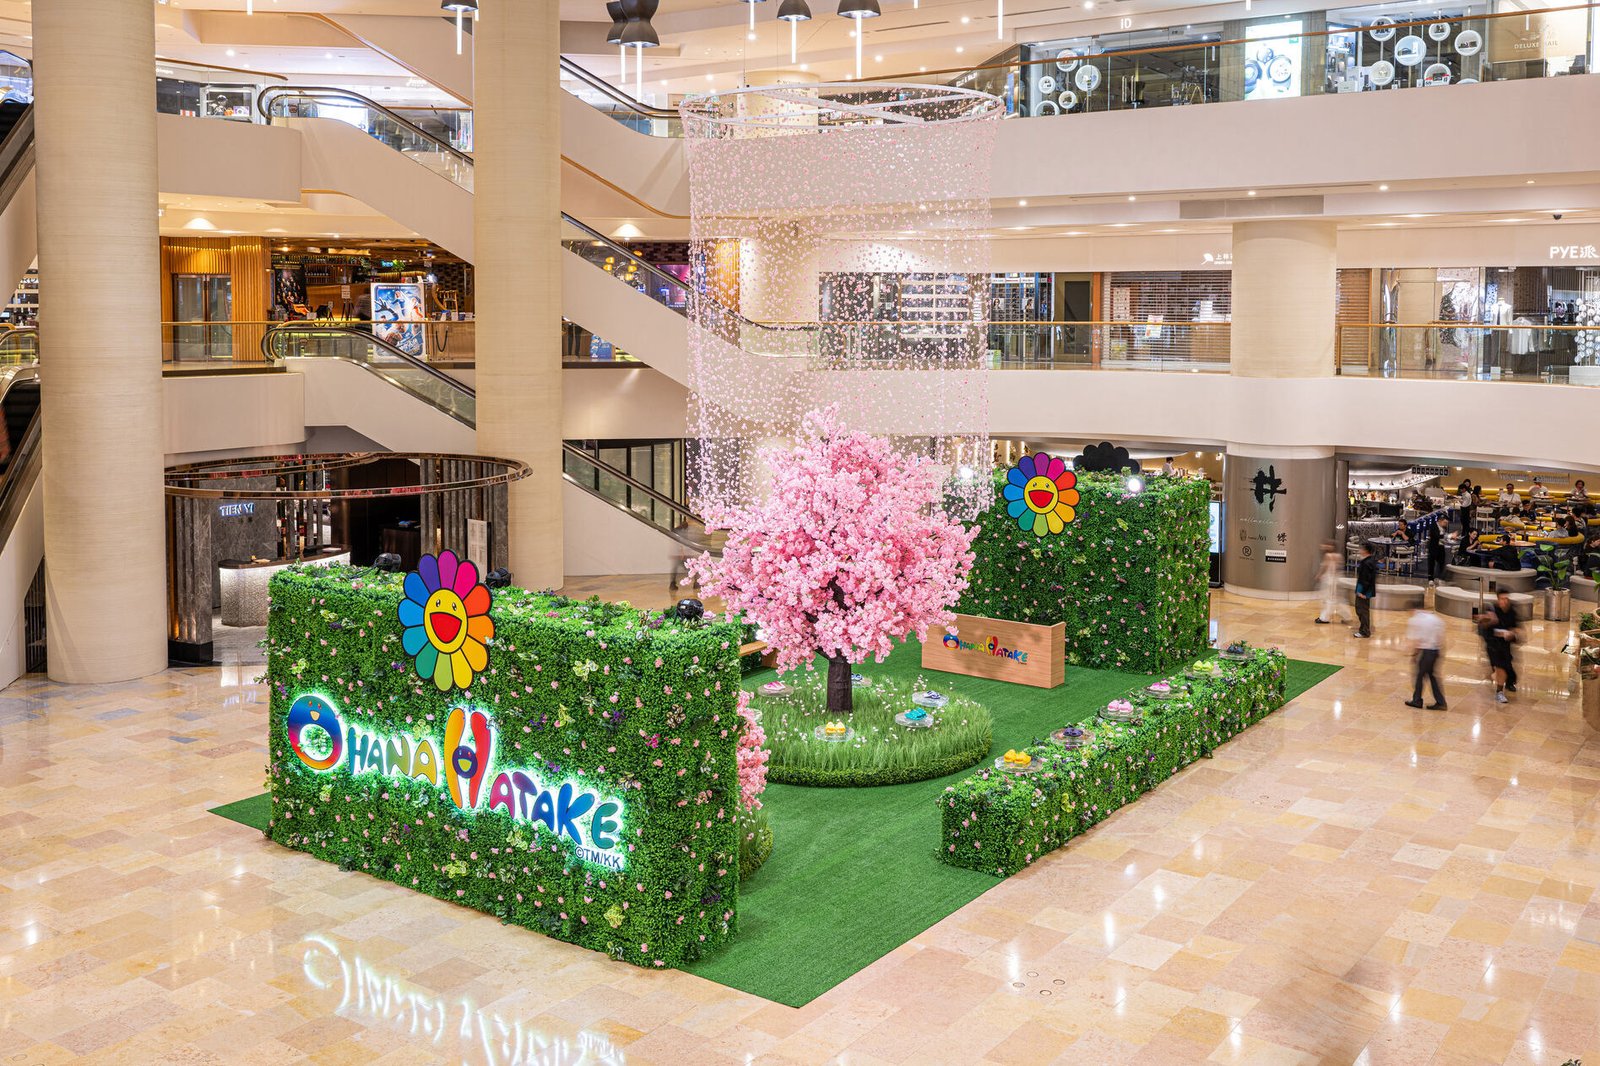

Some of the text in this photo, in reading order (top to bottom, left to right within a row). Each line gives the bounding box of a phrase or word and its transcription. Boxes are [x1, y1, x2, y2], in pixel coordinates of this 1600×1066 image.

[943, 634, 1028, 662] OHANA HATAKE
[287, 694, 620, 850] OHANA HATAKE
[575, 845, 622, 870] ©TM/KK
